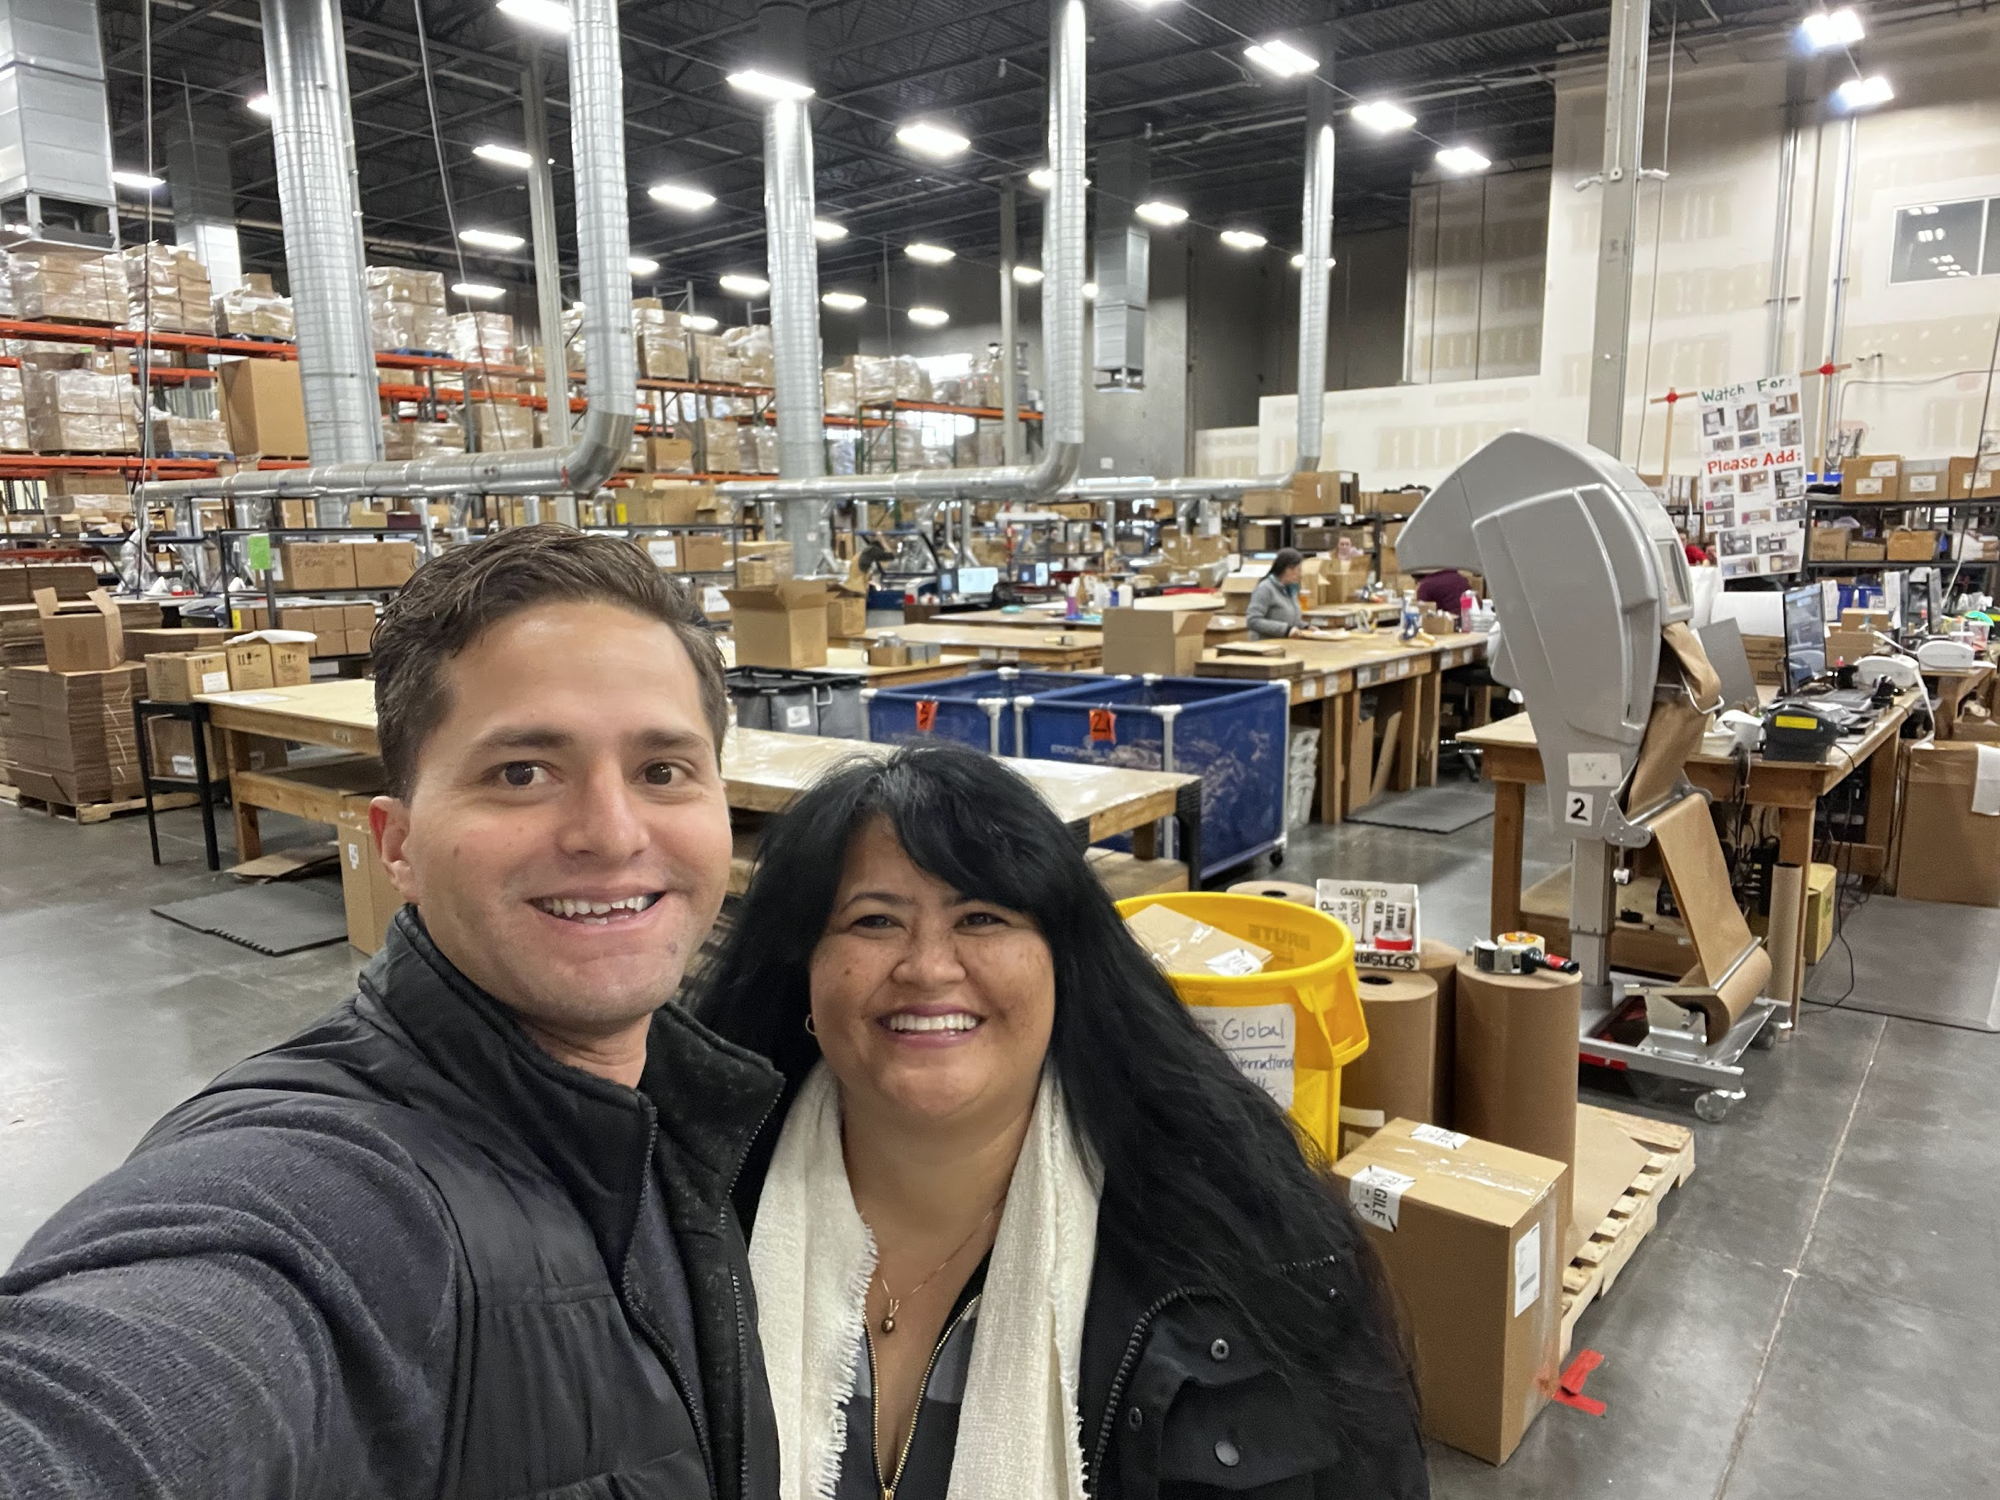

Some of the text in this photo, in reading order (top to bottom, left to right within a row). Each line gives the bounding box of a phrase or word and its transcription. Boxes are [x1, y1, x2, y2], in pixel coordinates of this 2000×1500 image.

[1701, 384, 1745, 403] Watch
[1707, 449, 1801, 474] Please Add:
[1570, 797, 1588, 821] 2
[1351, 901, 1360, 924] ONLY
[1396, 907, 1406, 928] ONLY
[1221, 1018, 1285, 1041] Global
[1236, 1053, 1294, 1070] ternational
